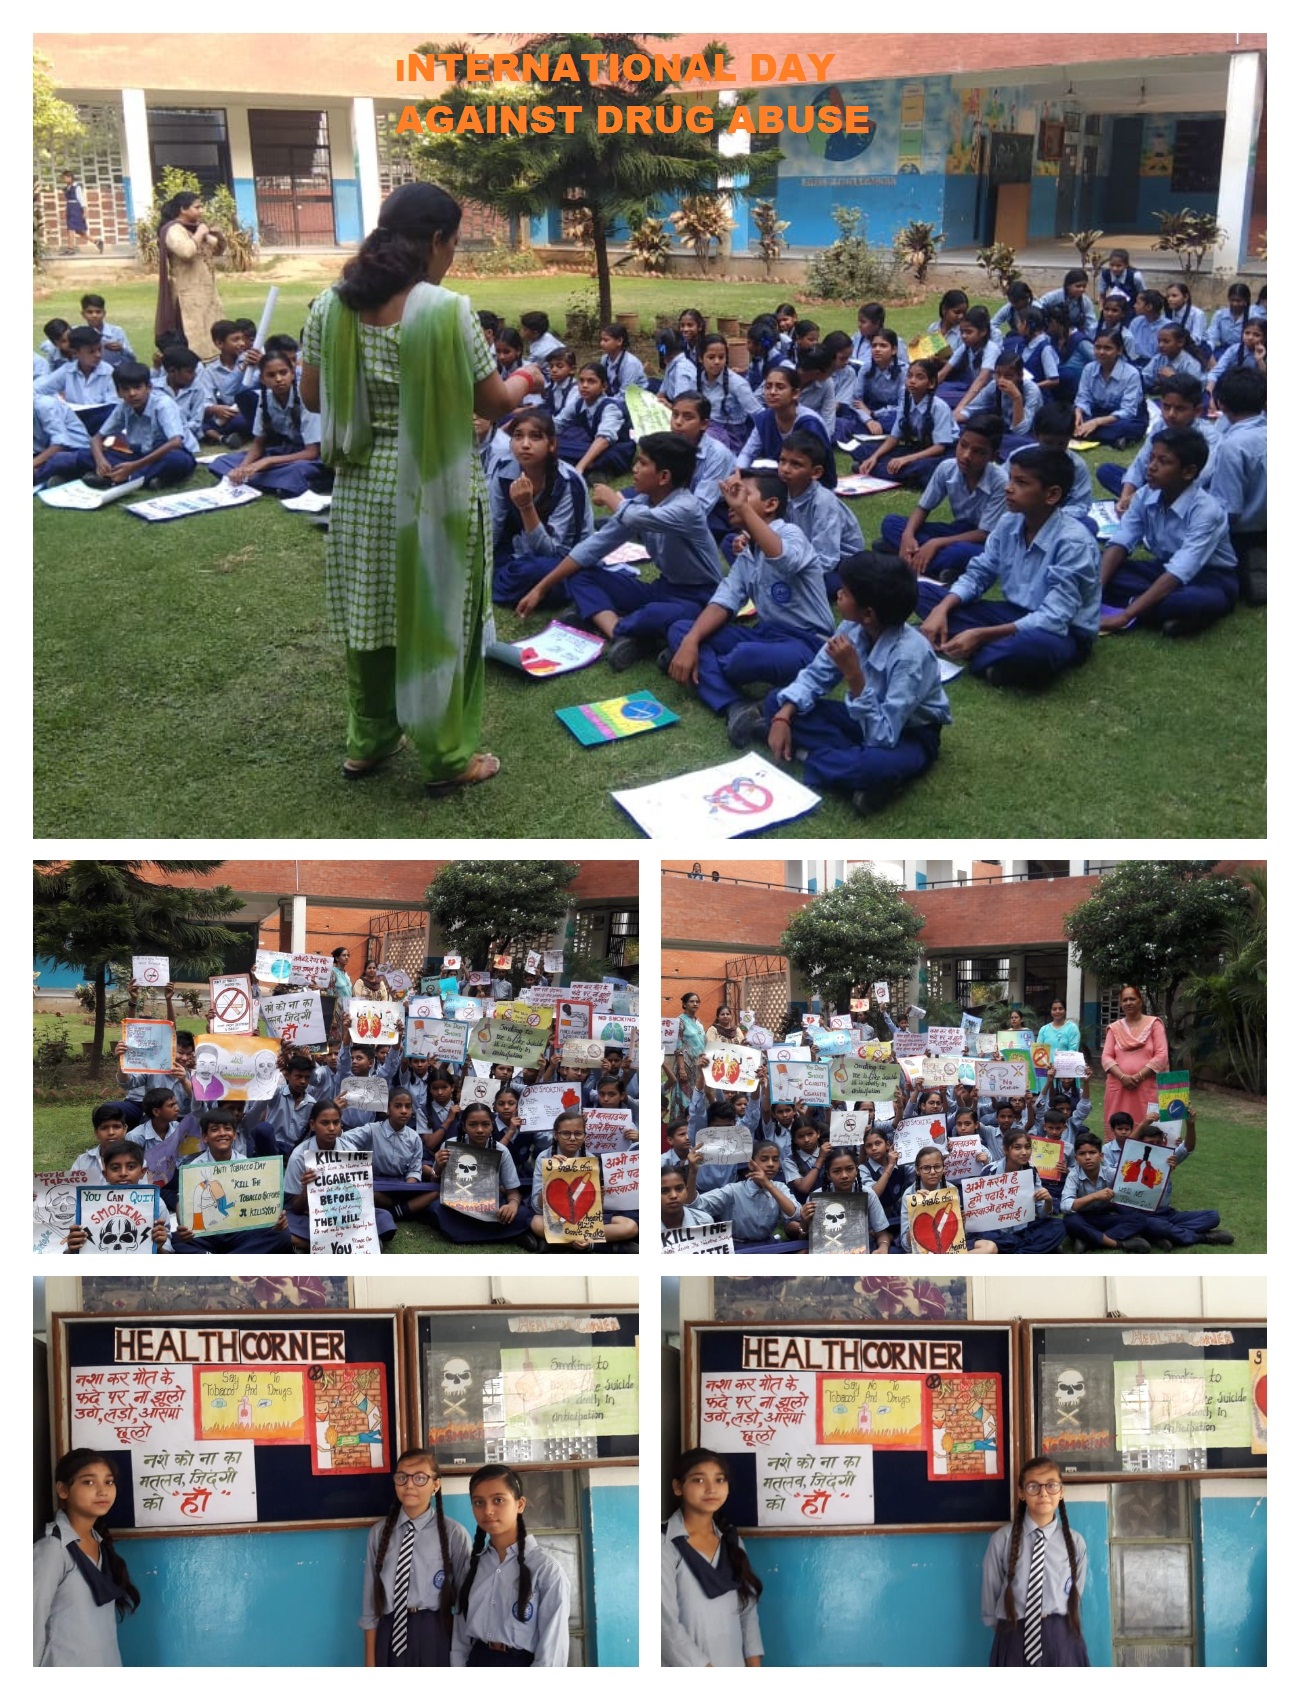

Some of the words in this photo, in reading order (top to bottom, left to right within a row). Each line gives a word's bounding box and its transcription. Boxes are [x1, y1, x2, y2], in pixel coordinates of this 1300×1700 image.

[315, 1170, 369, 1187] CIGARETTE
[83, 1191, 101, 1202] YOU
[107, 1190, 124, 1202] CAN
[129, 1191, 155, 1204] QUIT
[320, 1193, 355, 1206] BEFORE
[90, 1204, 147, 1227] SMOKING
[314, 1216, 338, 1227] THEY
[341, 1213, 360, 1224] KILL
[331, 1241, 353, 1254] YOU
[115, 1329, 239, 1362] HEALTH
[241, 1332, 345, 1361] CORNER
[743, 1338, 860, 1370] HEALTH
[862, 1341, 963, 1370] CORNER
[595, 1354, 609, 1370] to
[75, 1373, 104, 1388] नशा
[107, 1371, 130, 1386] कर
[132, 1367, 159, 1390] मौत
[160, 1367, 175, 1385] के
[1208, 1367, 1223, 1383] to
[705, 1379, 733, 1393] नशा
[735, 1378, 756, 1392] कर
[759, 1374, 784, 1395] मौत
[785, 1375, 799, 1391] के
[108, 1390, 129, 1406] पर
[133, 1390, 151, 1404] ना
[736, 1395, 756, 1410] पर
[759, 1396, 776, 1409] ना
[143, 1449, 170, 1470] नशे
[174, 1450, 195, 1466] को
[199, 1452, 220, 1465] ना
[223, 1451, 242, 1464] का
[767, 1452, 793, 1472] नशे
[797, 1453, 816, 1469] को
[820, 1456, 839, 1469] ना
[843, 1455, 861, 1468] का
[142, 1493, 164, 1511] को
[765, 1494, 786, 1511] को
